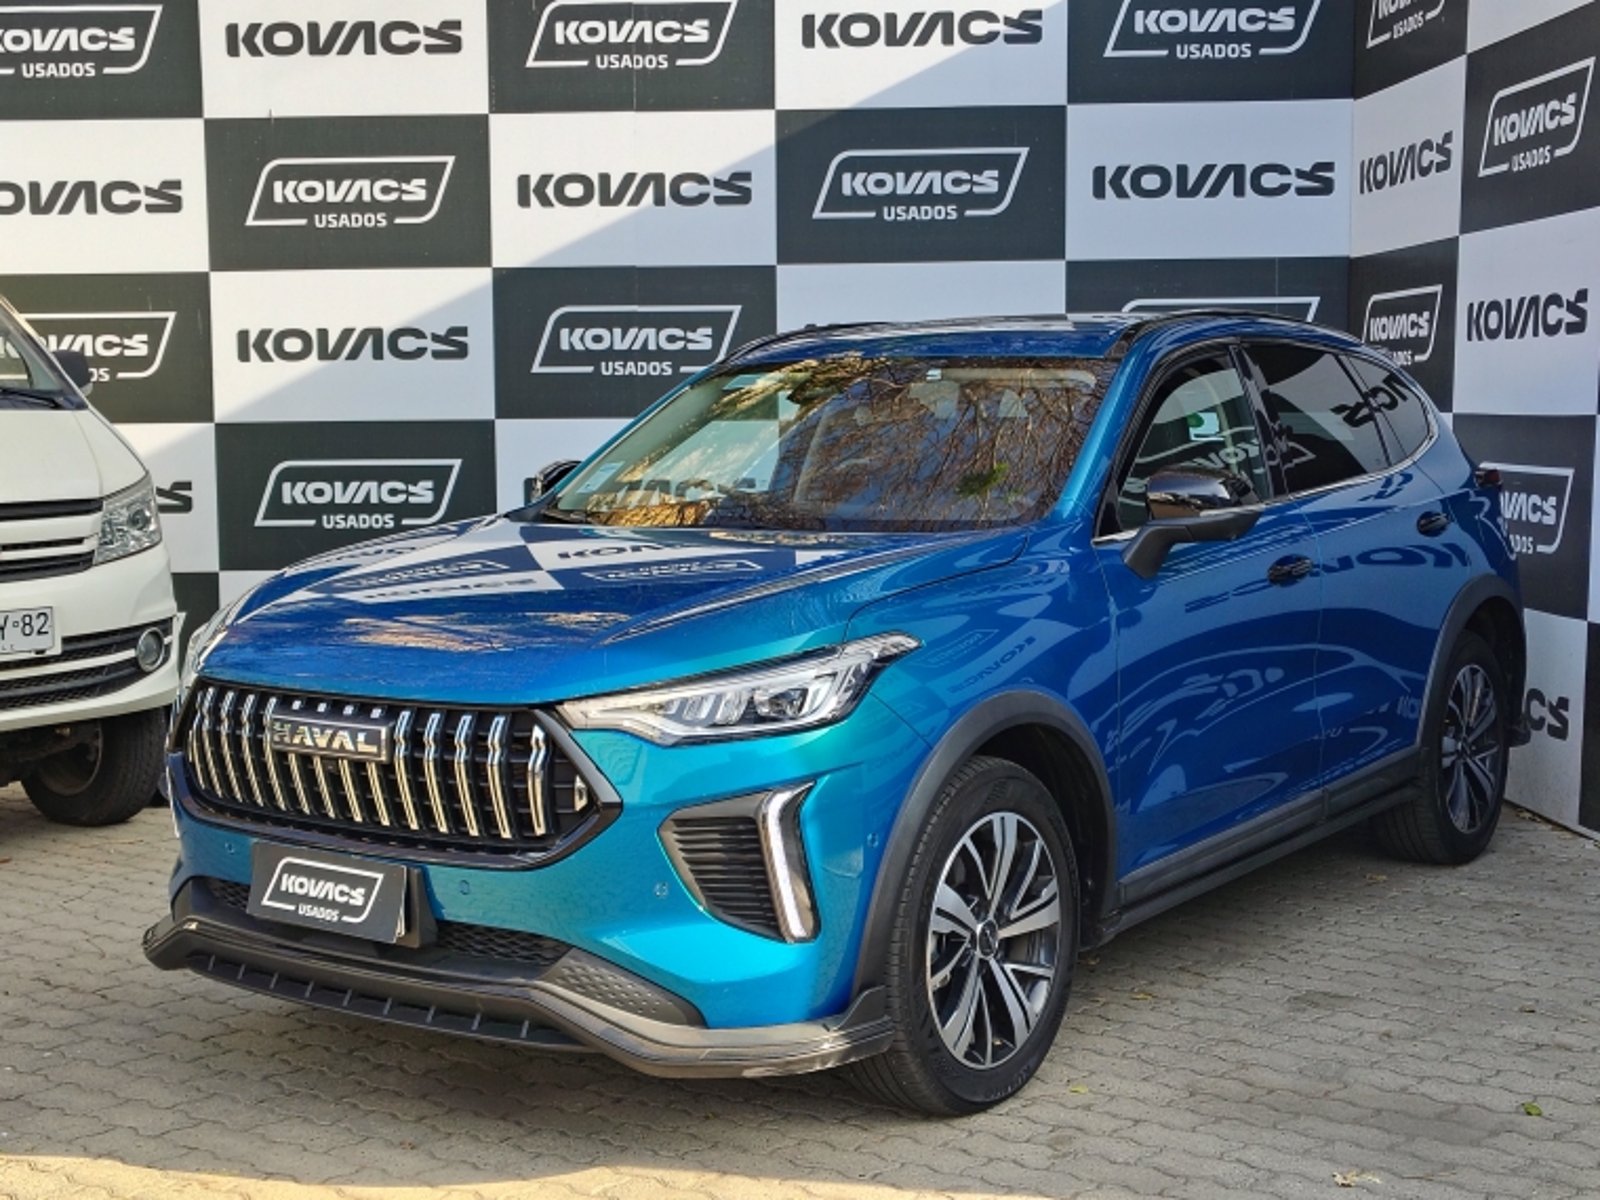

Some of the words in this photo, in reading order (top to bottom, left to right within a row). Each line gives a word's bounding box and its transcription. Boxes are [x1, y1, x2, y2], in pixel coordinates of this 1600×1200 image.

[555, 20, 710, 45] KOVACS
[802, 9, 1043, 49] KOVACS
[1135, 6, 1296, 34] KOVACS
[0, 27, 136, 53] OVACS
[226, 20, 463, 58] KOVACS
[1176, 44, 1252, 59] USADOS
[22, 62, 96, 78] USADOS
[596, 54, 669, 70] USADOS
[1494, 92, 1577, 146] KOVACS
[1360, 130, 1453, 195] KOVACS
[1512, 145, 1551, 173] USADOS
[273, 178, 427, 204] KOVACS
[517, 171, 753, 208] KOVACS
[842, 169, 999, 196] KOVACS
[1092, 161, 1335, 200] KOVACS
[0, 179, 183, 216] OVACS
[314, 212, 388, 228] USADOS
[883, 205, 958, 221] USADOS
[1370, 311, 1430, 342] KOVACS
[1466, 287, 1589, 342] KOVACS
[237, 326, 469, 363] KOVACS
[560, 327, 713, 351] KOVACS
[601, 361, 673, 376] USADOS
[281, 480, 434, 505] KOVACS
[321, 513, 395, 529] USADOS
[272, 721, 378, 754] HAVAL
[280, 873, 366, 906] KOVACS
[298, 903, 340, 922] USADOS
